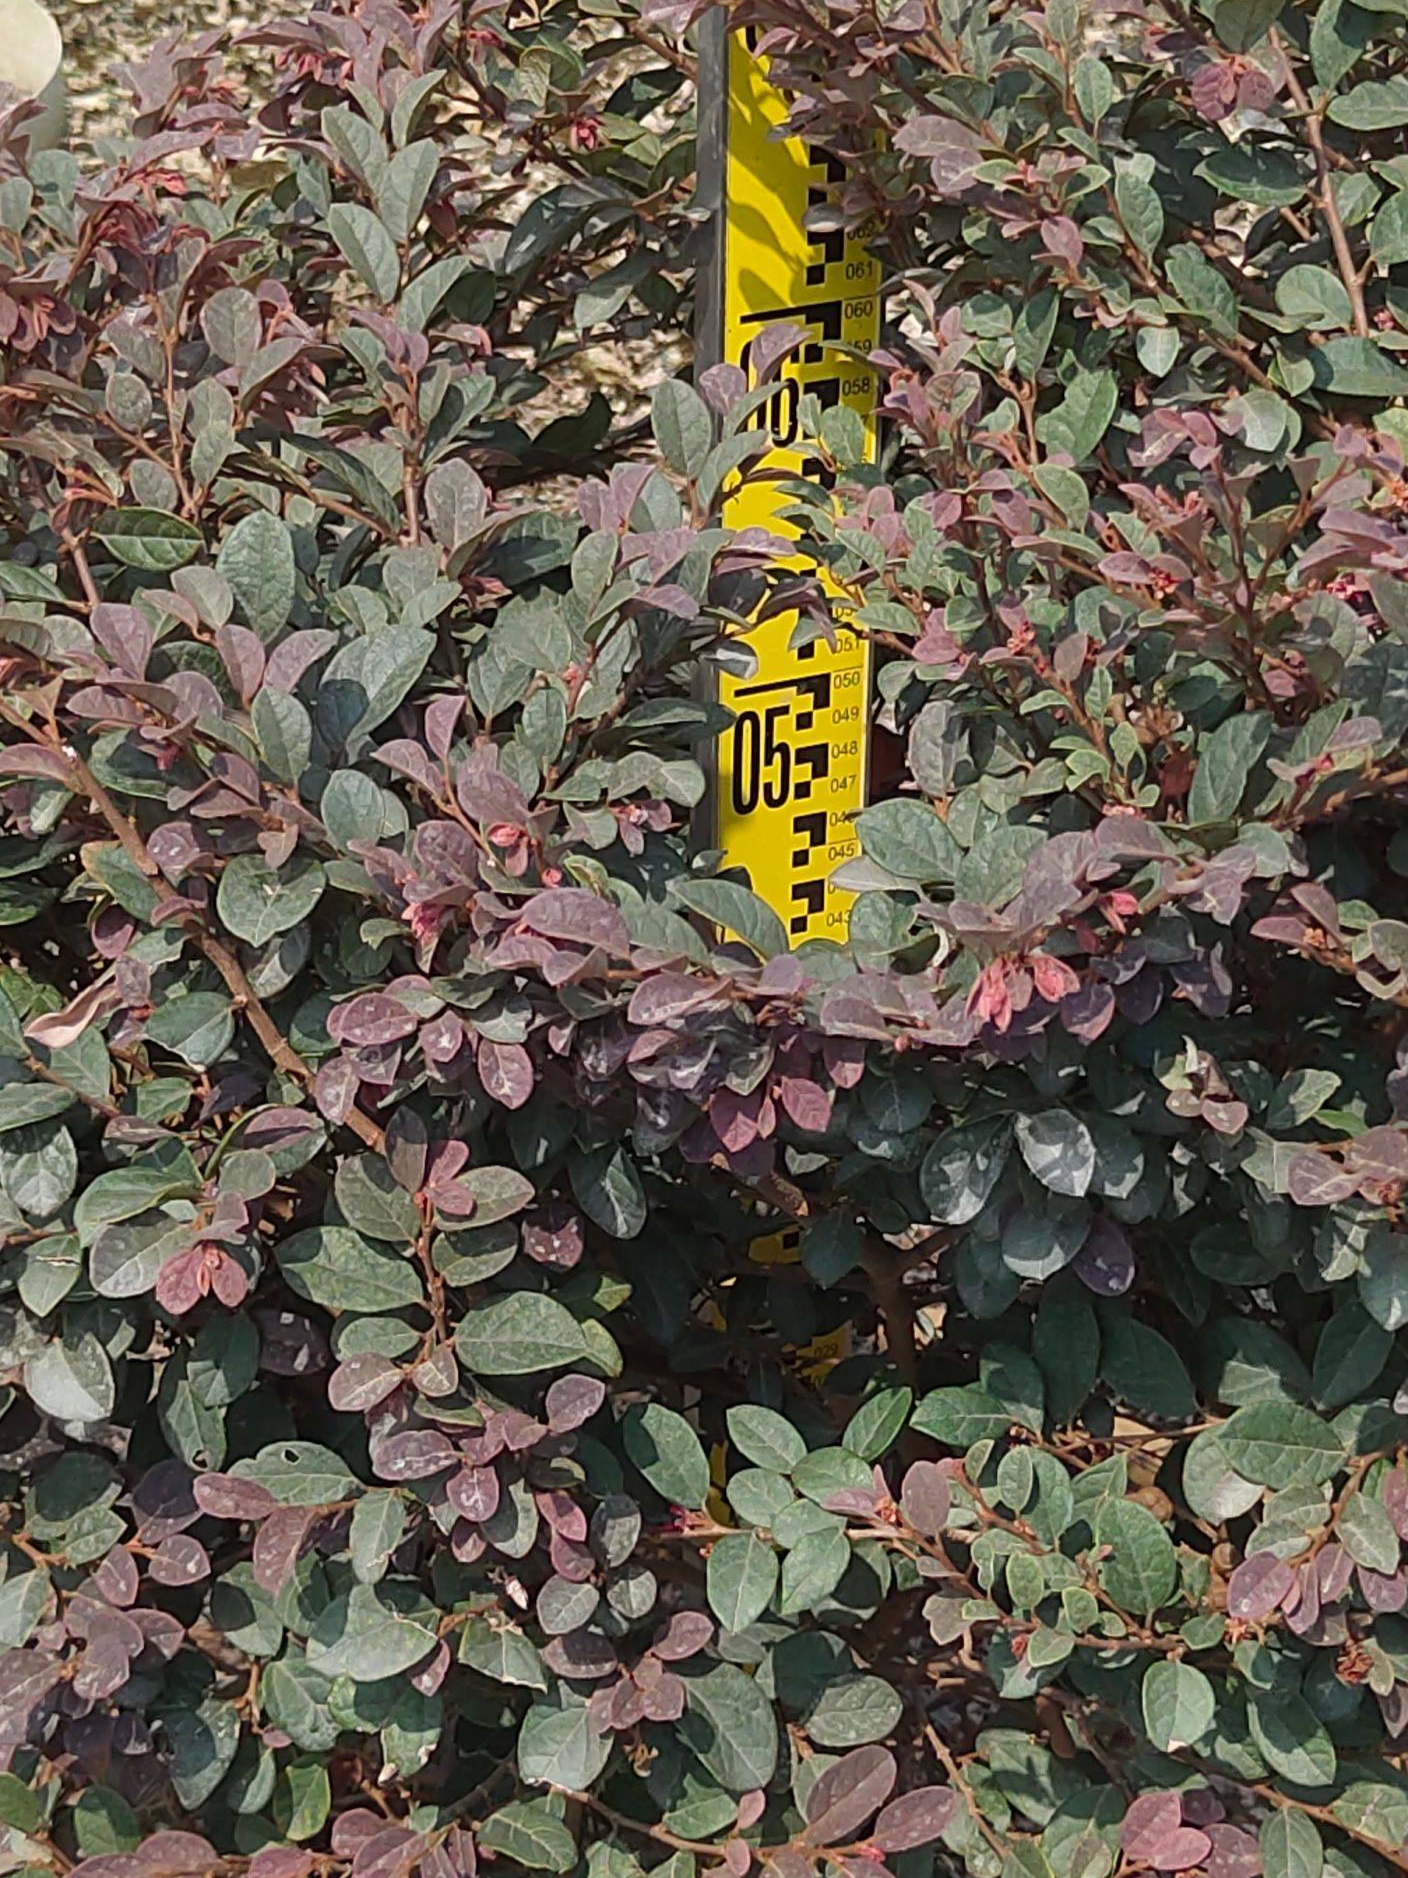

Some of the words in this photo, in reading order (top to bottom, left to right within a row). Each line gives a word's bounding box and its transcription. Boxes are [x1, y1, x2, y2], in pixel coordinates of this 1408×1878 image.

[844, 301, 872, 319] 060
[842, 378, 870, 396] 058
[833, 672, 860, 690] 050
[832, 706, 859, 724] 049
[831, 741, 858, 759] 048
[732, 705, 791, 815] 05
[830, 775, 857, 793] 047
[828, 843, 855, 861] 045
